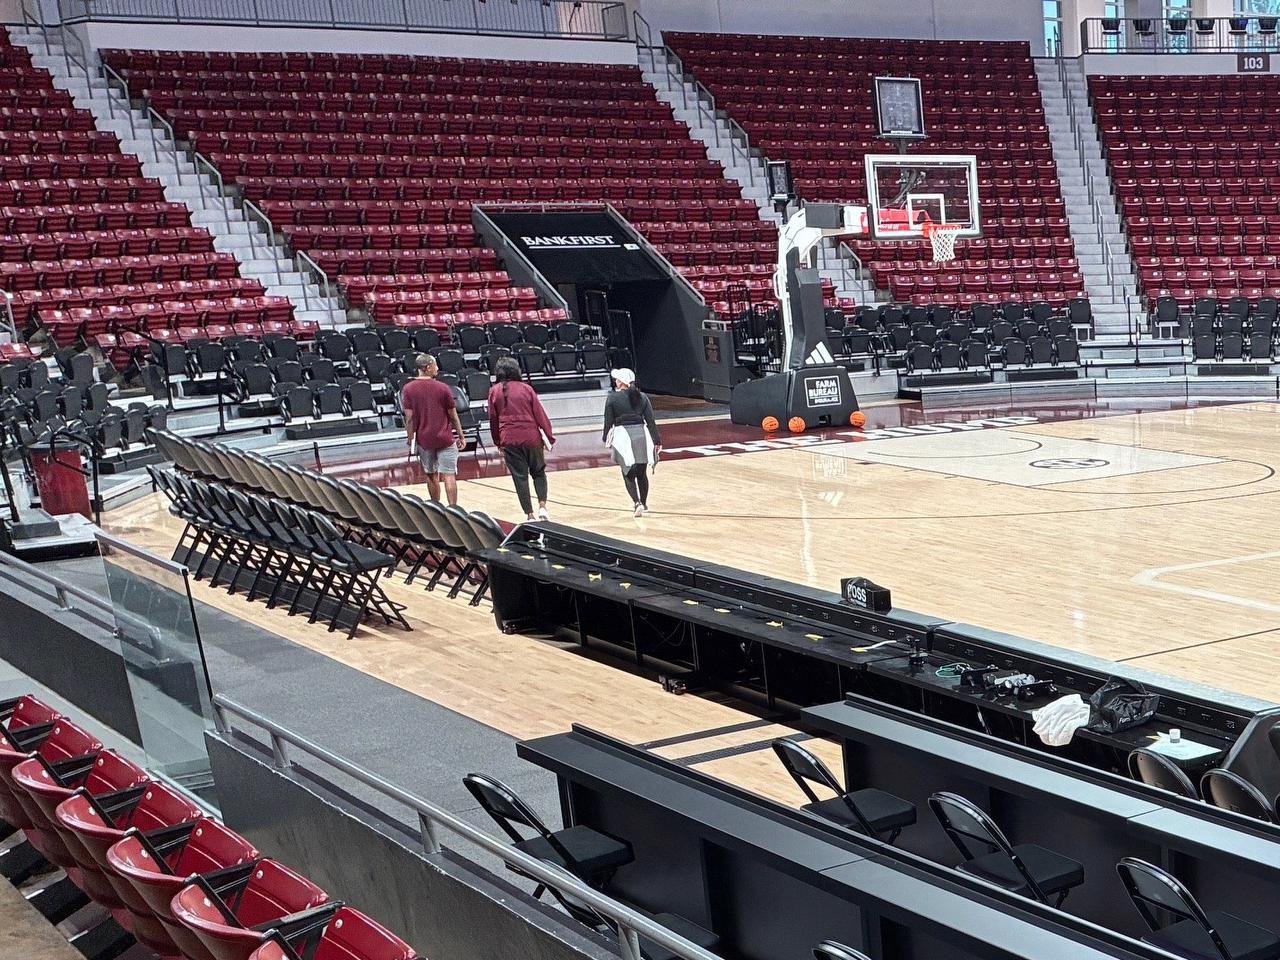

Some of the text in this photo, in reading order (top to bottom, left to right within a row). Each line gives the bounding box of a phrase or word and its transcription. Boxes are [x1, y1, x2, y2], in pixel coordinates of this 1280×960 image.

[1243, 57, 1264, 70] 103
[815, 379, 837, 388] FARM
[808, 387, 838, 397] BUREAU
